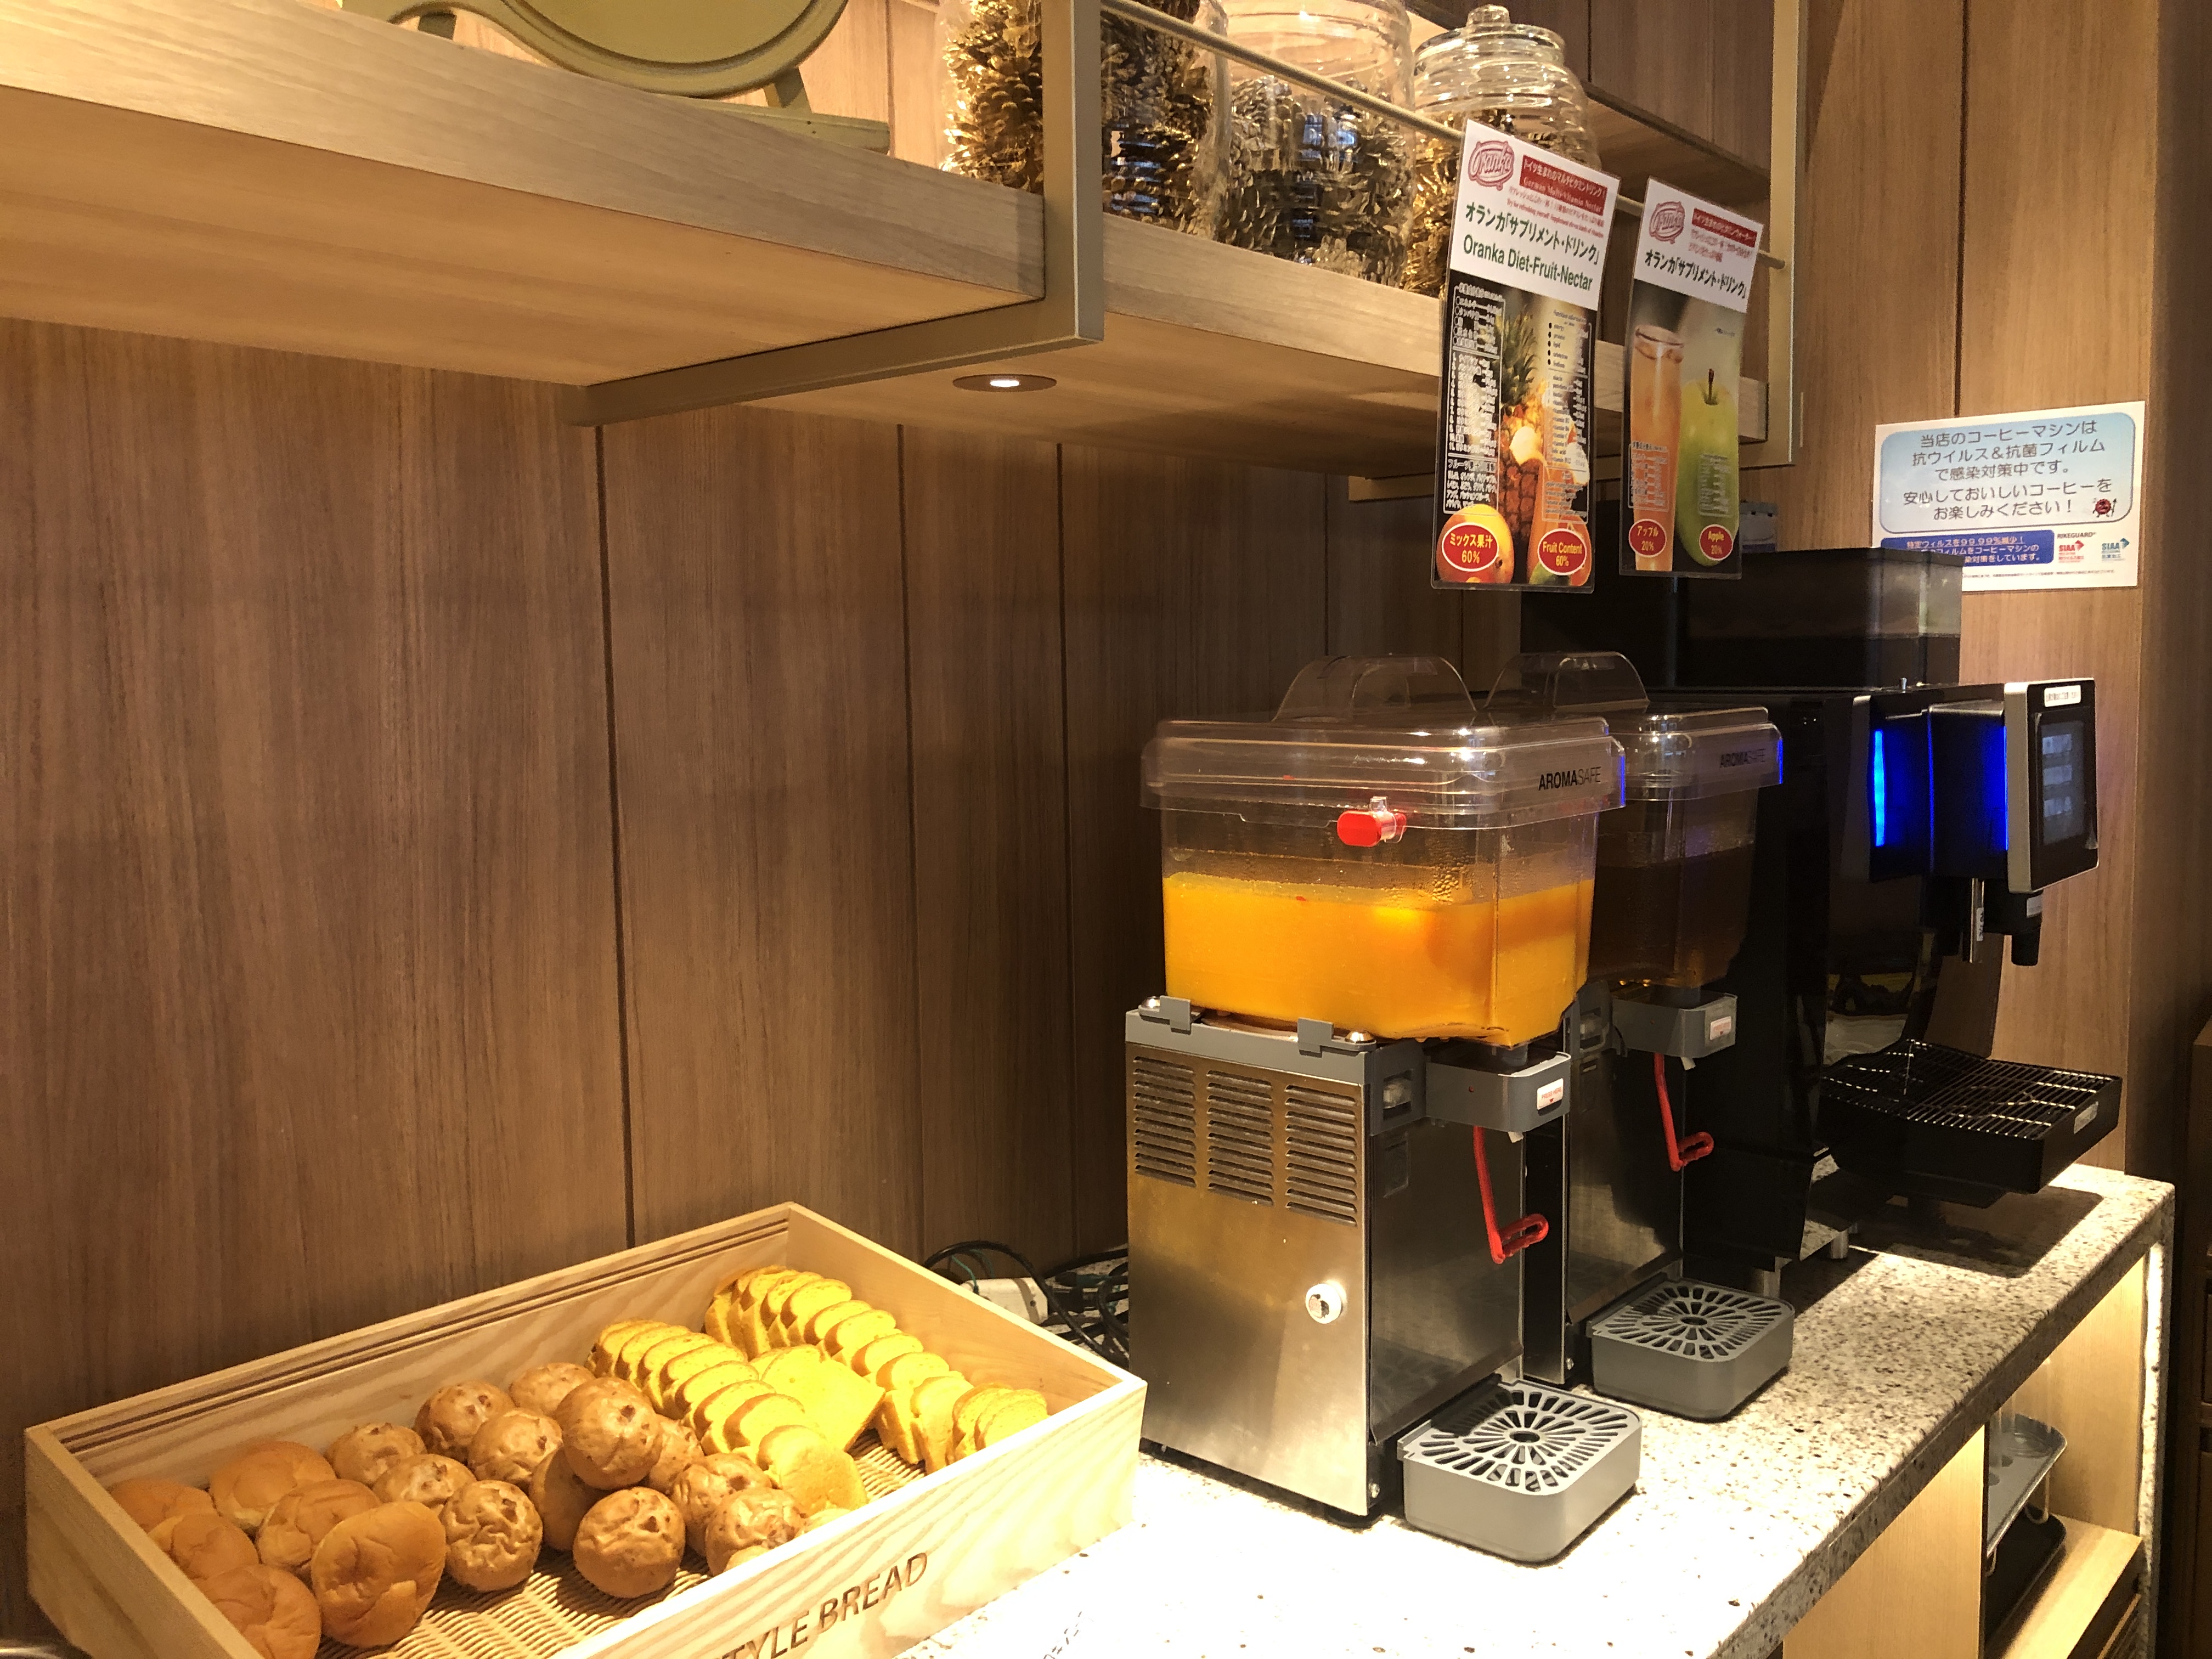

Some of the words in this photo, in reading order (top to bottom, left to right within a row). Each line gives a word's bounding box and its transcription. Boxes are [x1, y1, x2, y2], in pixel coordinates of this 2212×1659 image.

[1469, 143, 1513, 181] Oranka
[1463, 234, 1504, 264] Oranka
[1508, 248, 1593, 291] Diet-Fruit-Nectar
[1920, 420, 2098, 448] 当店のコーヒーマシンは
[1935, 460, 2069, 482] で感染対策中です。
[1903, 478, 2112, 505] 安心しておいしいコーヒーを
[1933, 499, 2072, 520] お楽しみください！
[1449, 533, 1493, 549] ミックス果汁
[1641, 541, 1655, 552] 20%
[1708, 531, 1724, 543] Apple
[1462, 550, 1480, 564] 60%
[1543, 541, 1558, 553] Fruit
[1558, 543, 1583, 555] Content
[1555, 555, 1569, 567] 60%
[1538, 766, 1601, 791] AROMASAFE
[712, 1610, 810, 1659] TYLE
[817, 1553, 928, 1633] BREAD
